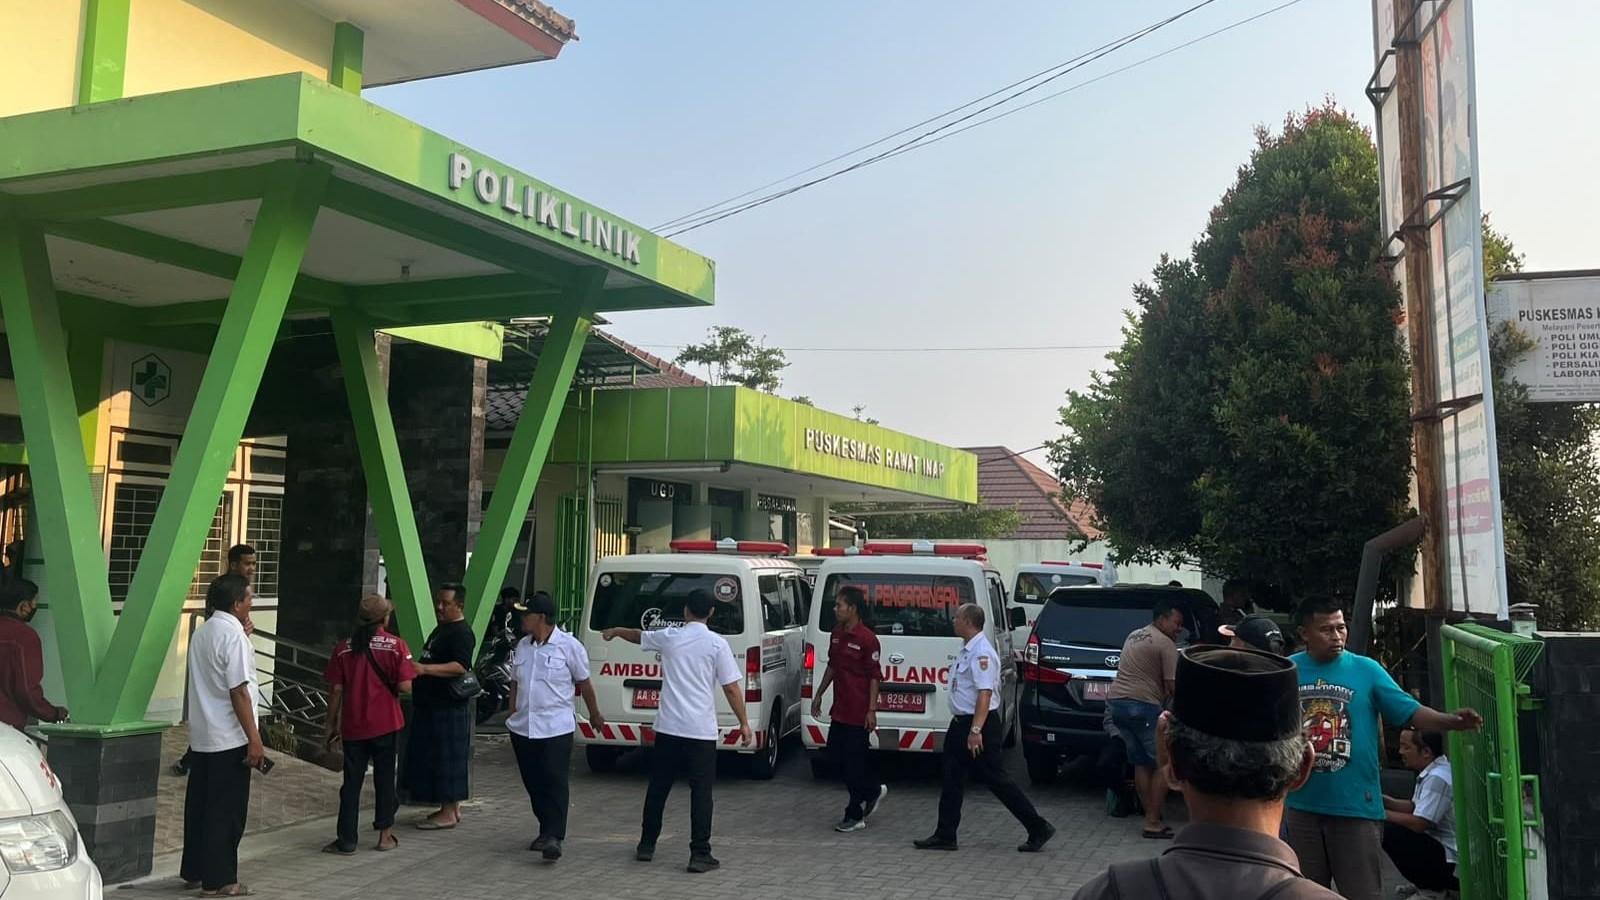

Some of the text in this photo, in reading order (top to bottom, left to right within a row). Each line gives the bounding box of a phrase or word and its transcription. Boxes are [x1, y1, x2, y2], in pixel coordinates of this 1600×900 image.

[448, 152, 641, 265] POLIKLINIK
[1519, 307, 1593, 321] PUSKESMAS
[1551, 333, 1575, 341] POLI
[1551, 342, 1576, 350] POLI
[1552, 351, 1599, 359] POLI KIA
[804, 427, 945, 479] PUSKESMAS RAWAT INAP
[651, 482, 675, 498] UGD
[882, 665, 950, 685] ULANC
[1087, 682, 1098, 693] AA
[636, 690, 648, 700] AA
[911, 695, 922, 705] XB
